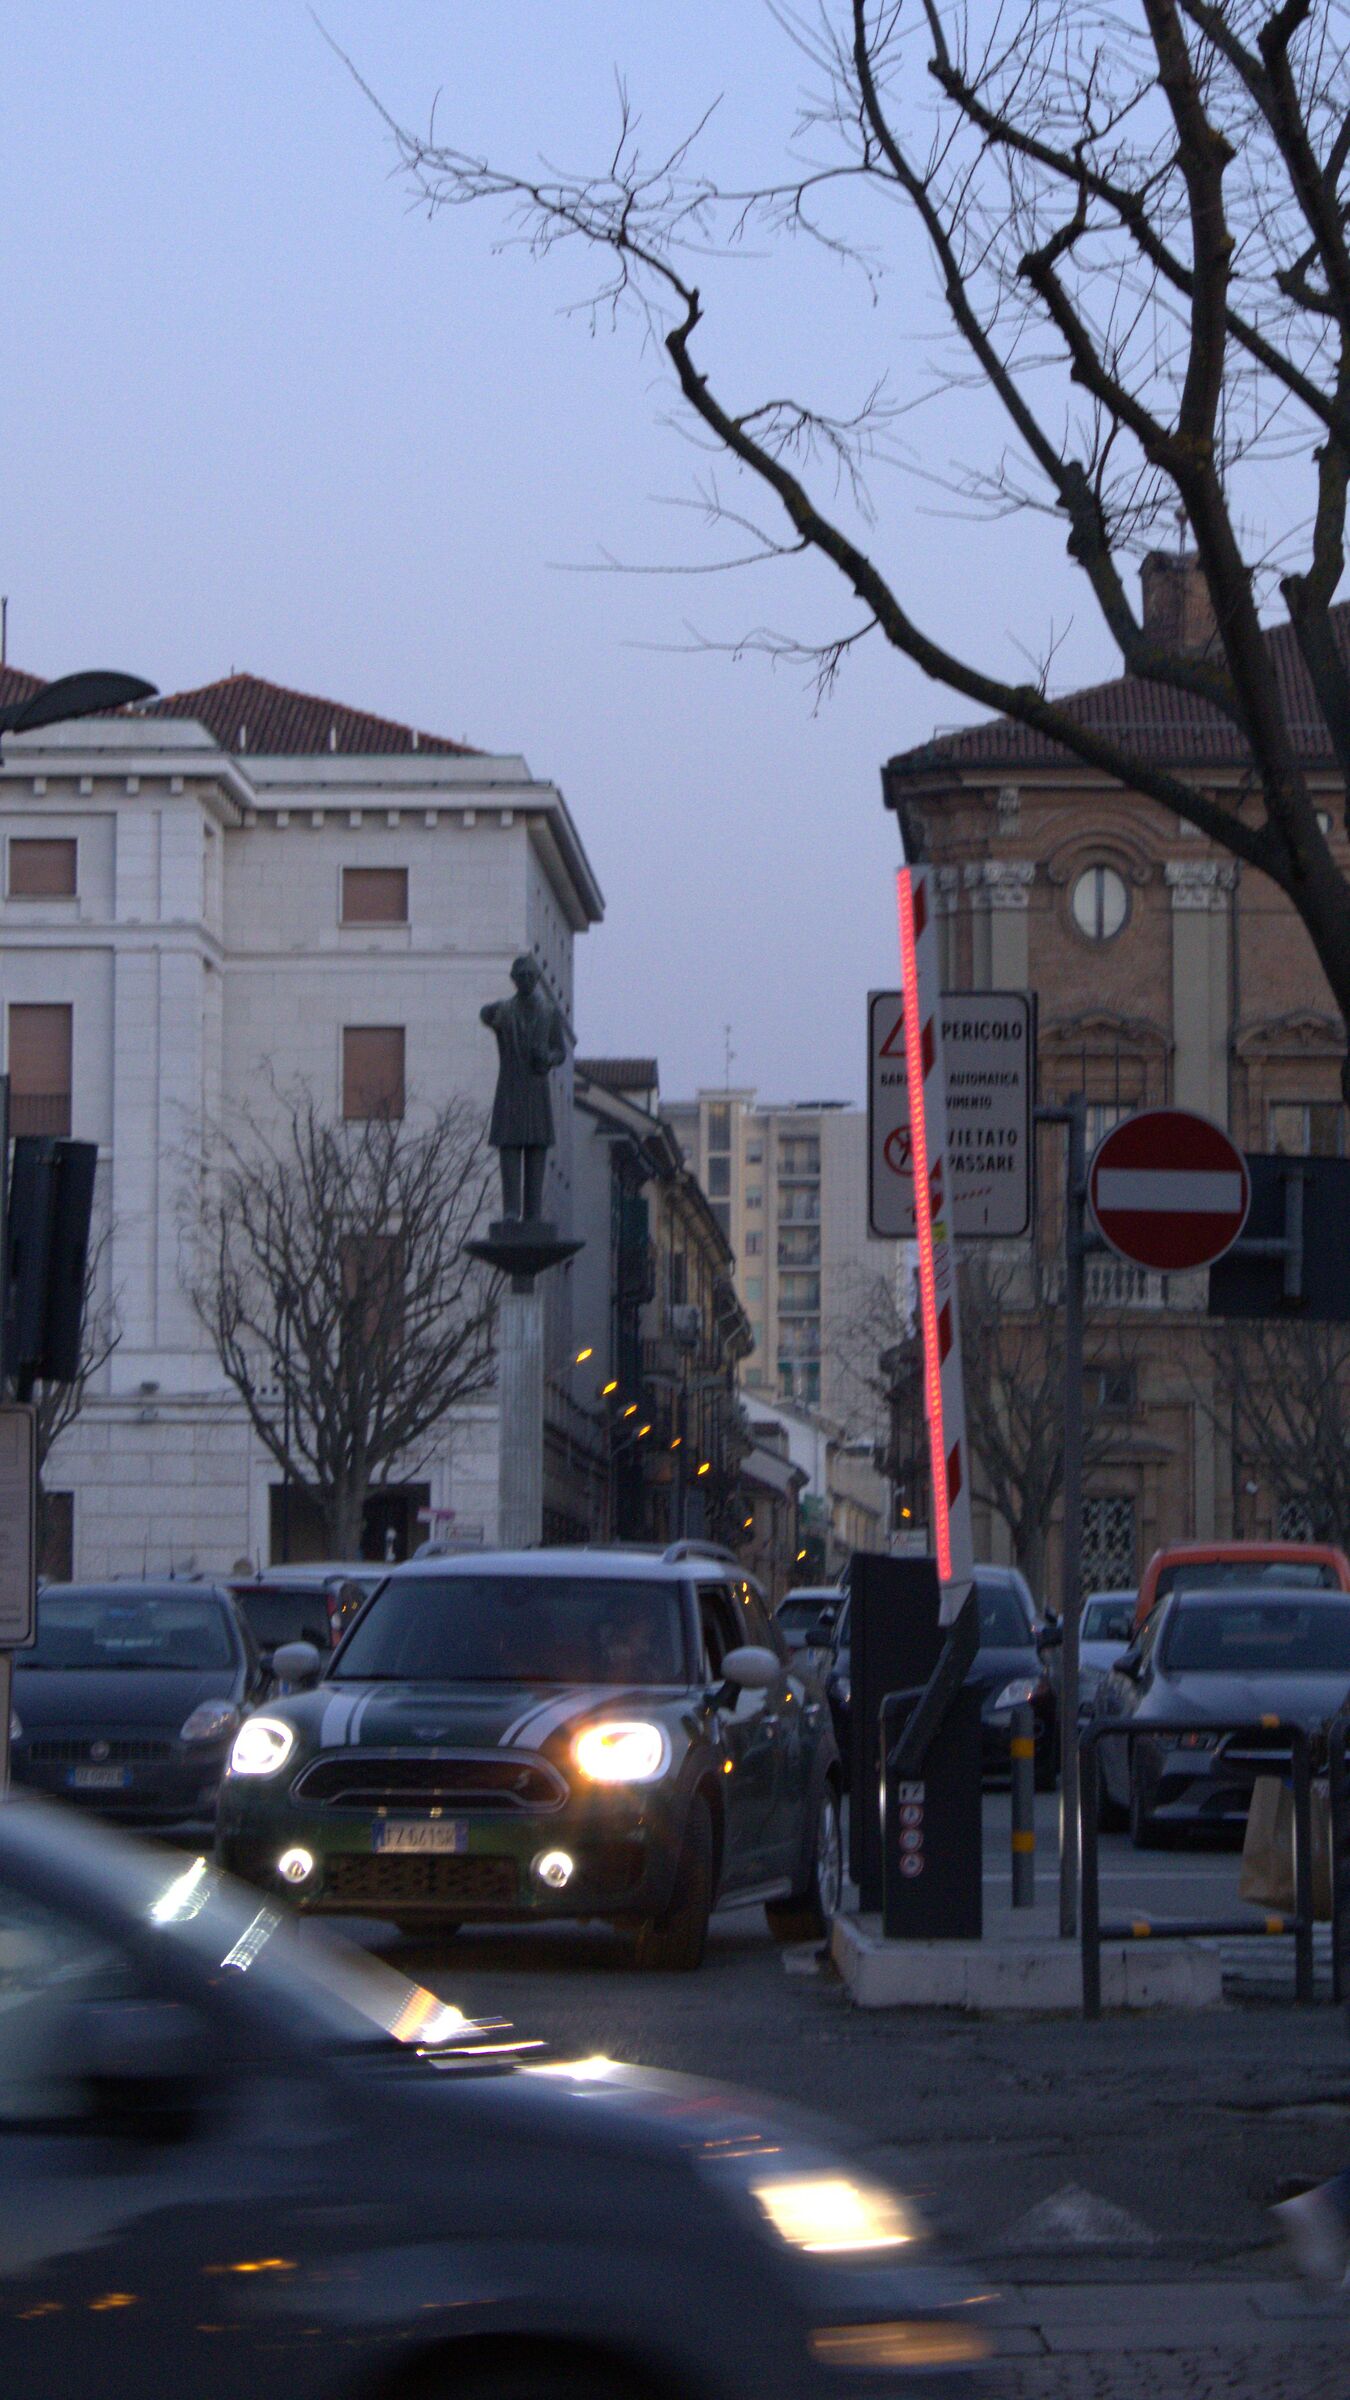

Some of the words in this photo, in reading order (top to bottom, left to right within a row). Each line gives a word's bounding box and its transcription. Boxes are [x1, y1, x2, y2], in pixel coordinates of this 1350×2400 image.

[942, 1021, 1023, 1041] PERICOLO
[881, 1073, 909, 1087] BAR
[949, 1071, 1019, 1087] AUTOMATICA
[946, 1095, 992, 1111] VIMENTO
